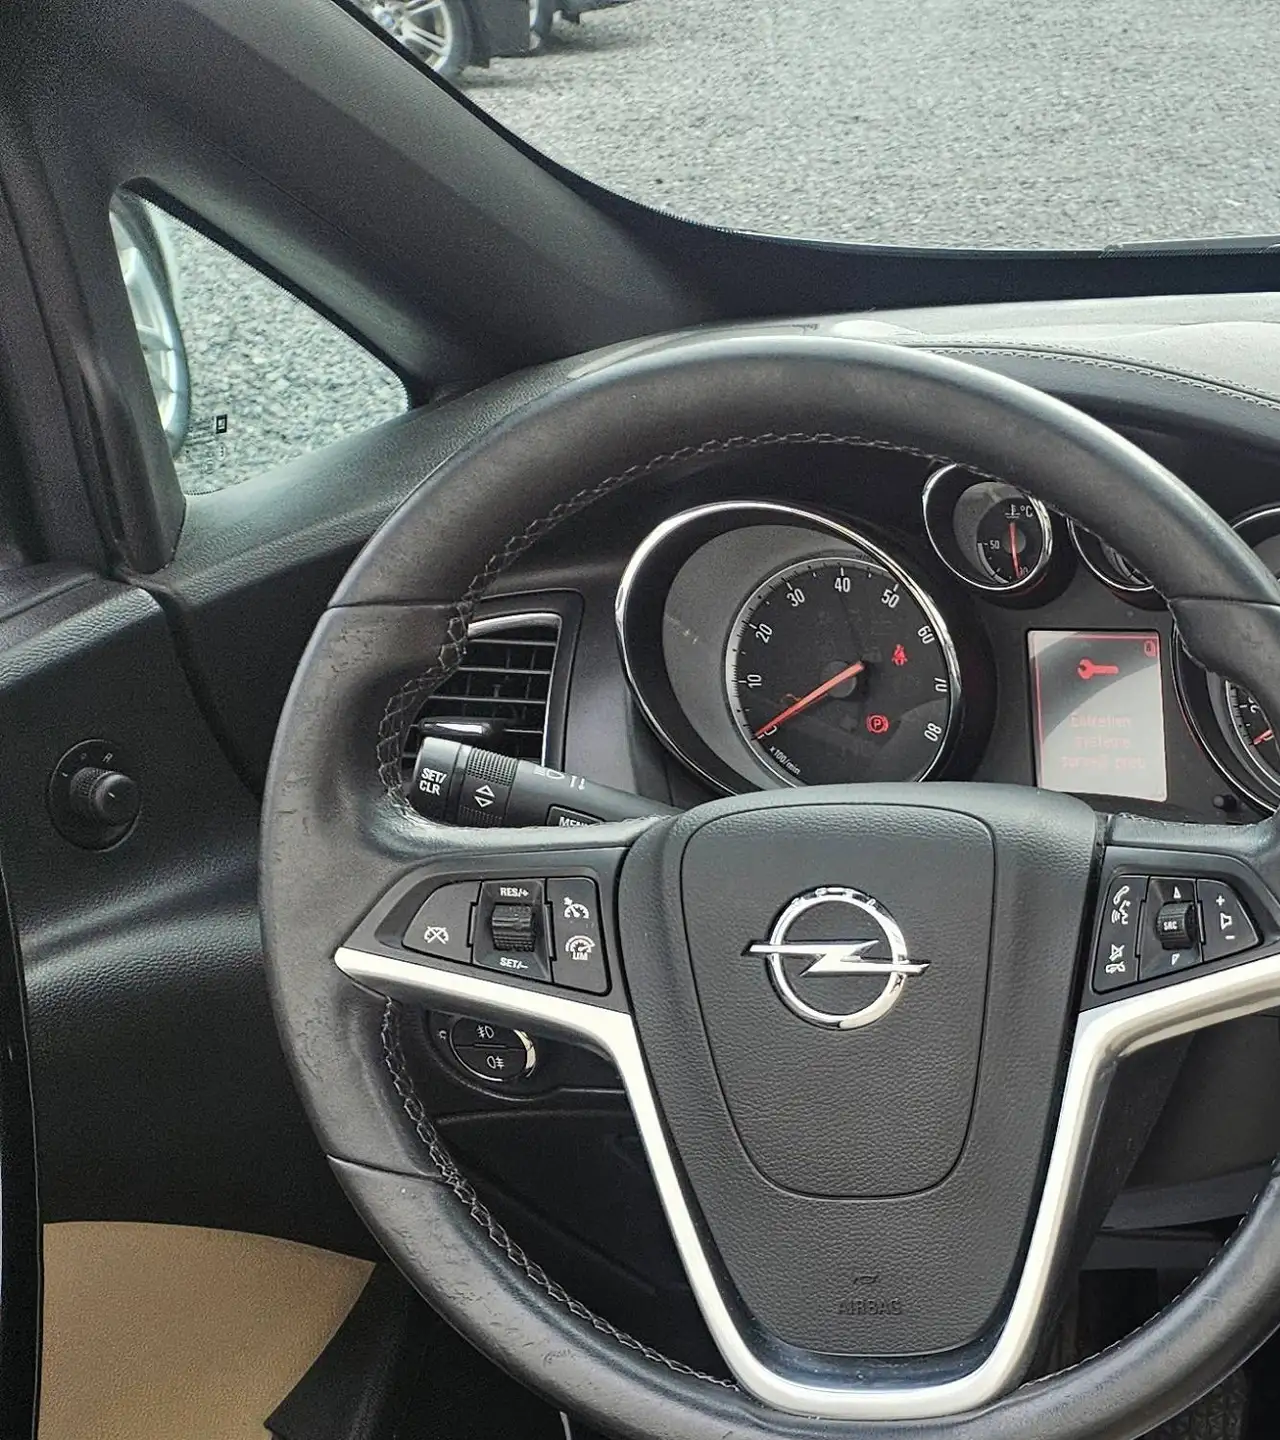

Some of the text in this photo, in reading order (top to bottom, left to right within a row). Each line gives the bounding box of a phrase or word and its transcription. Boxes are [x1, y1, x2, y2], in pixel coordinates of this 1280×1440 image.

[834, 578, 851, 593] 40
[786, 588, 806, 608] 30
[881, 587, 900, 609] 50
[755, 623, 773, 644] 20
[917, 625, 936, 645] 60
[746, 672, 762, 689] 10
[924, 722, 943, 742] 80
[420, 767, 448, 784] SET/
[419, 781, 441, 796] CLR
[1163, 920, 1178, 931] SRC
[838, 1299, 902, 1316] AIRBAG
